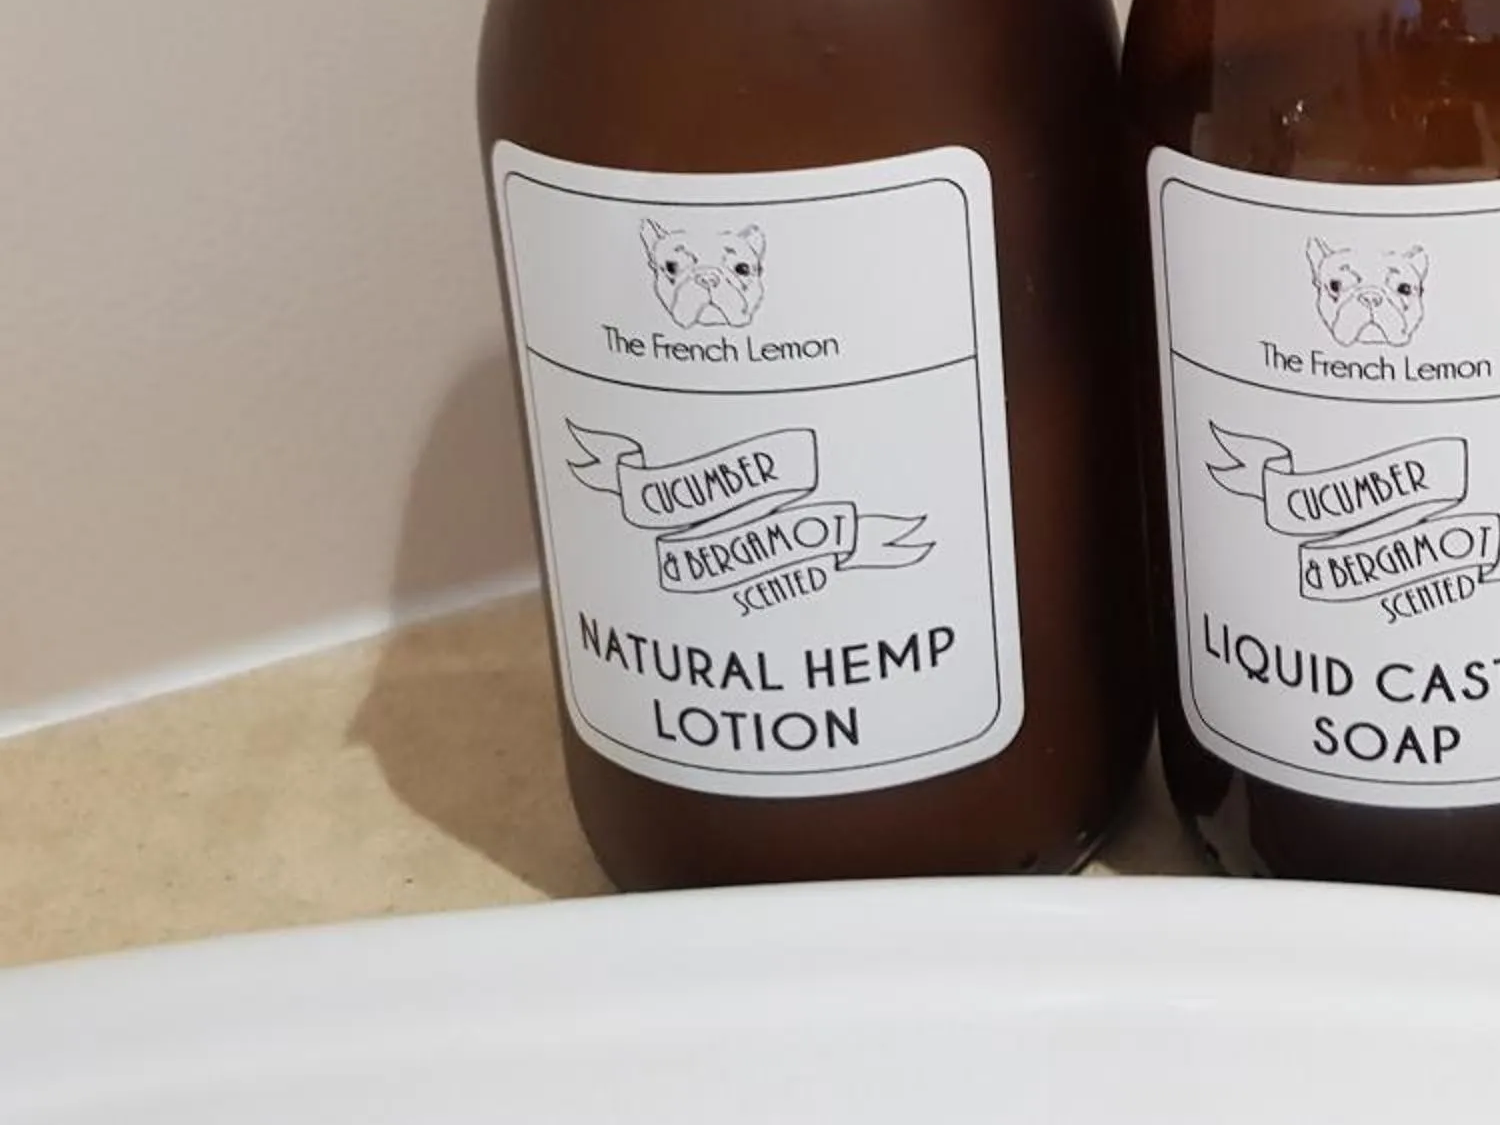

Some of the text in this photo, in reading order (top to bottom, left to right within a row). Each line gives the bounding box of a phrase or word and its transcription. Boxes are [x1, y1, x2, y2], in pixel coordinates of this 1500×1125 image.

[602, 324, 840, 363] The French Lemon
[1260, 340, 1492, 381] The French Lemon
[640, 450, 776, 516] CUCUMBER
[1287, 459, 1429, 522] CUCUMBER
[684, 513, 849, 582] BERGAMOT
[1327, 525, 1494, 590] BERGAMOT
[732, 566, 828, 617] SCENTED
[1380, 573, 1477, 624] SCENTED
[578, 610, 955, 692] NATURAL HEMP
[1203, 613, 1354, 698] LIQUID
[653, 699, 860, 752] LOTION
[1313, 716, 1462, 765] SOAP
